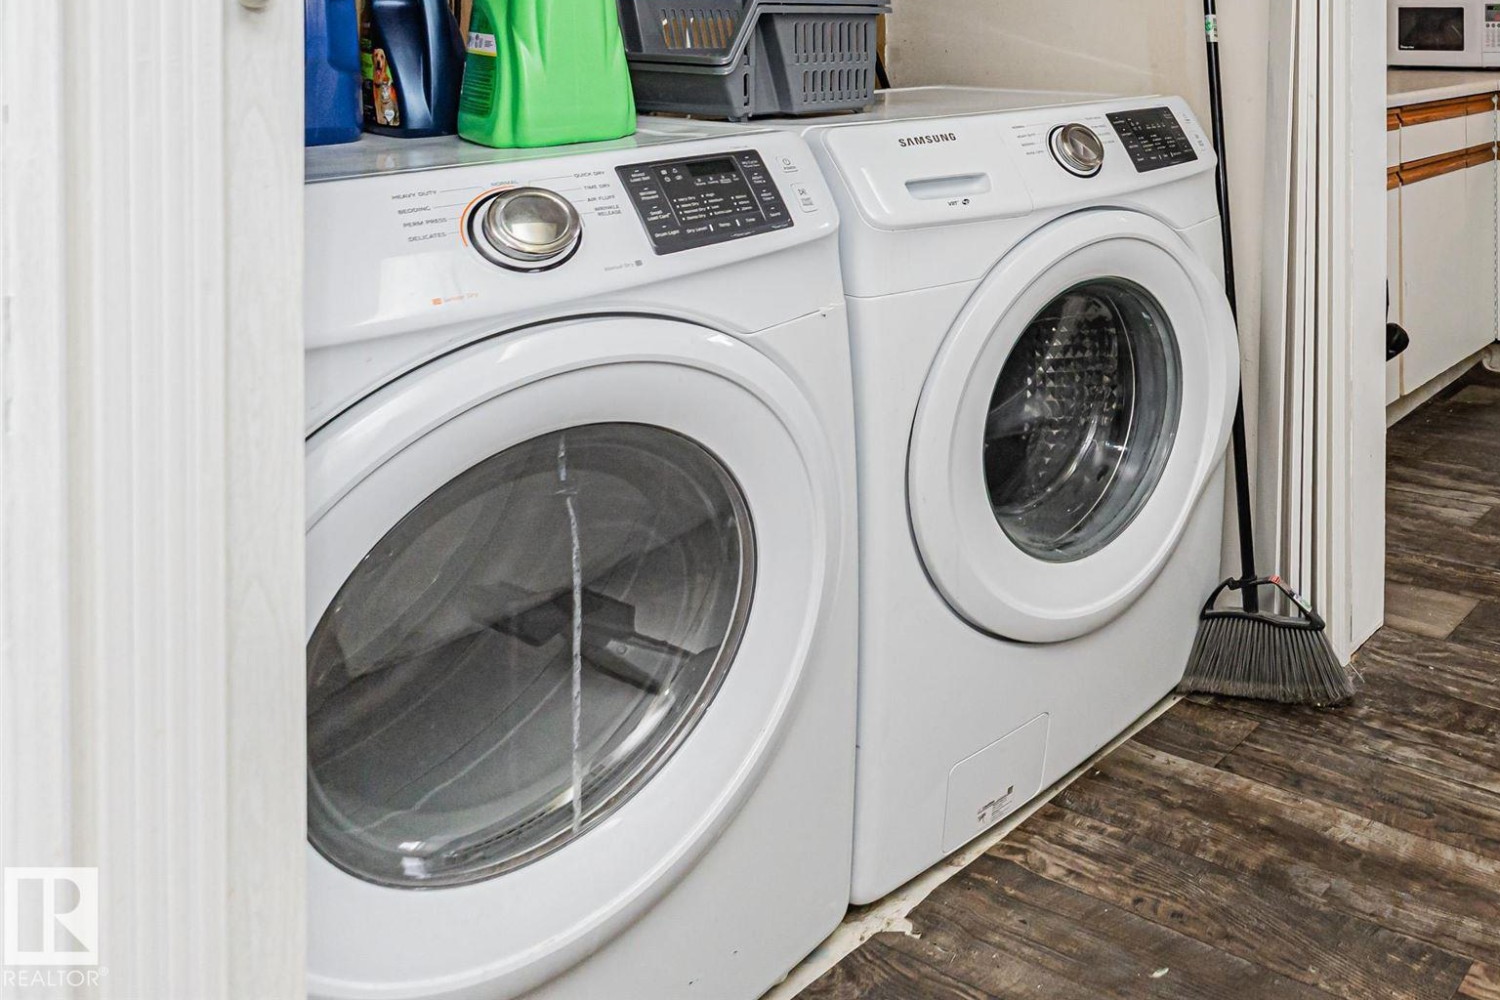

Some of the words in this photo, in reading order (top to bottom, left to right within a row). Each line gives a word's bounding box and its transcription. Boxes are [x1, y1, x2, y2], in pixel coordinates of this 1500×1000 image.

[898, 132, 957, 147] SAMSUNG
[392, 191, 416, 200] HEAVY
[397, 205, 431, 215] BEDDING
[425, 217, 447, 225] PRESS
[407, 232, 447, 242] DELICATES
